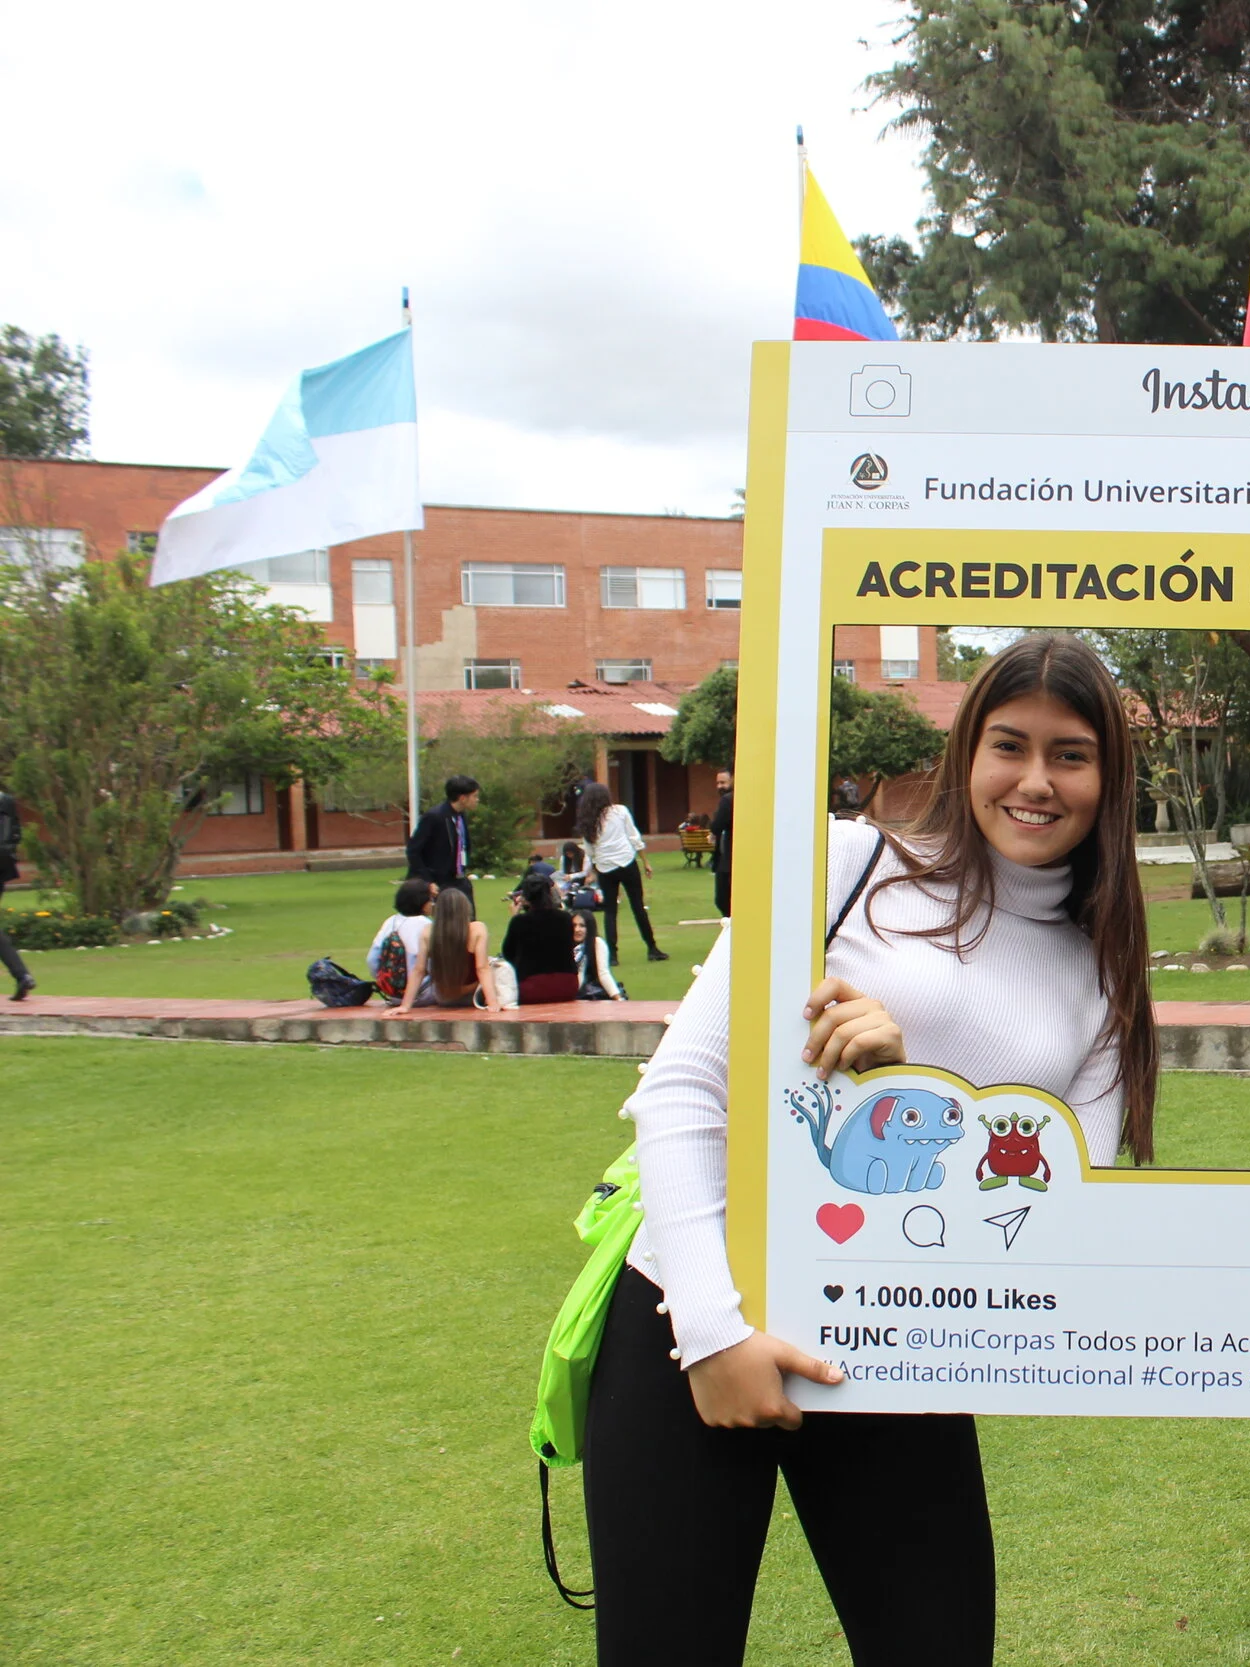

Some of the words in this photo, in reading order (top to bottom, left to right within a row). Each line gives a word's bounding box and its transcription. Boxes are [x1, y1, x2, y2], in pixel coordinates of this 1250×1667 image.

[925, 476, 1073, 502] Fundación
[826, 501, 853, 510] JUAN
[855, 501, 866, 510] N.
[868, 501, 910, 510] CORPAS
[856, 548, 1234, 603] ACREDITACIÓN
[856, 1285, 978, 1309] 1.000.000
[987, 1288, 1057, 1311] Likes
[820, 1325, 898, 1352] FUJNC
[906, 1327, 1055, 1356] @UniCorpas
[1062, 1330, 1137, 1352] Todos
[1145, 1336, 1187, 1358] por
[1194, 1331, 1213, 1353] la
[824, 1359, 1133, 1386] AcreditaciónInstitucional
[1140, 1366, 1243, 1393] #Corpas
